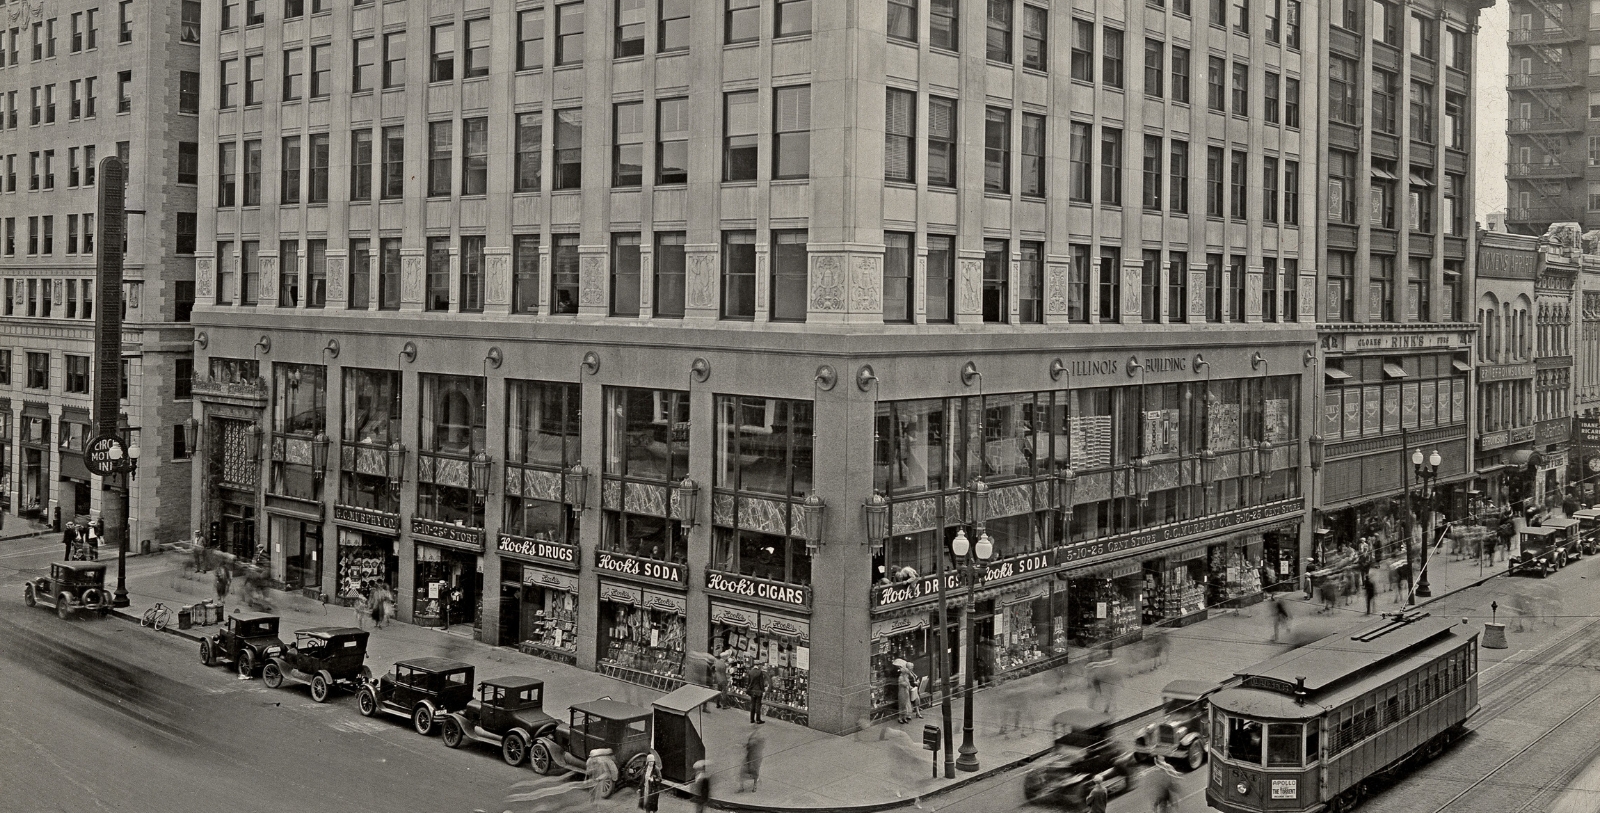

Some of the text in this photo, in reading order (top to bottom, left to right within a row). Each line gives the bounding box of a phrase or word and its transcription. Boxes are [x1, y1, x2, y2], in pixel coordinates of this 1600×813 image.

[1391, 335, 1424, 348] RINK'S
[1071, 357, 1186, 376] ILLINOIS BUILDING
[383, 517, 396, 529] CO.
[449, 528, 478, 544] STORE
[1107, 539, 1129, 553] CENT
[1130, 533, 1157, 549] STORE
[499, 536, 573, 561] Hook's DRUGS
[598, 554, 679, 582] Hook's SODA
[1018, 555, 1048, 573] SODA
[708, 573, 803, 604] Hook's CIGARS
[880, 583, 922, 605] Hook's
